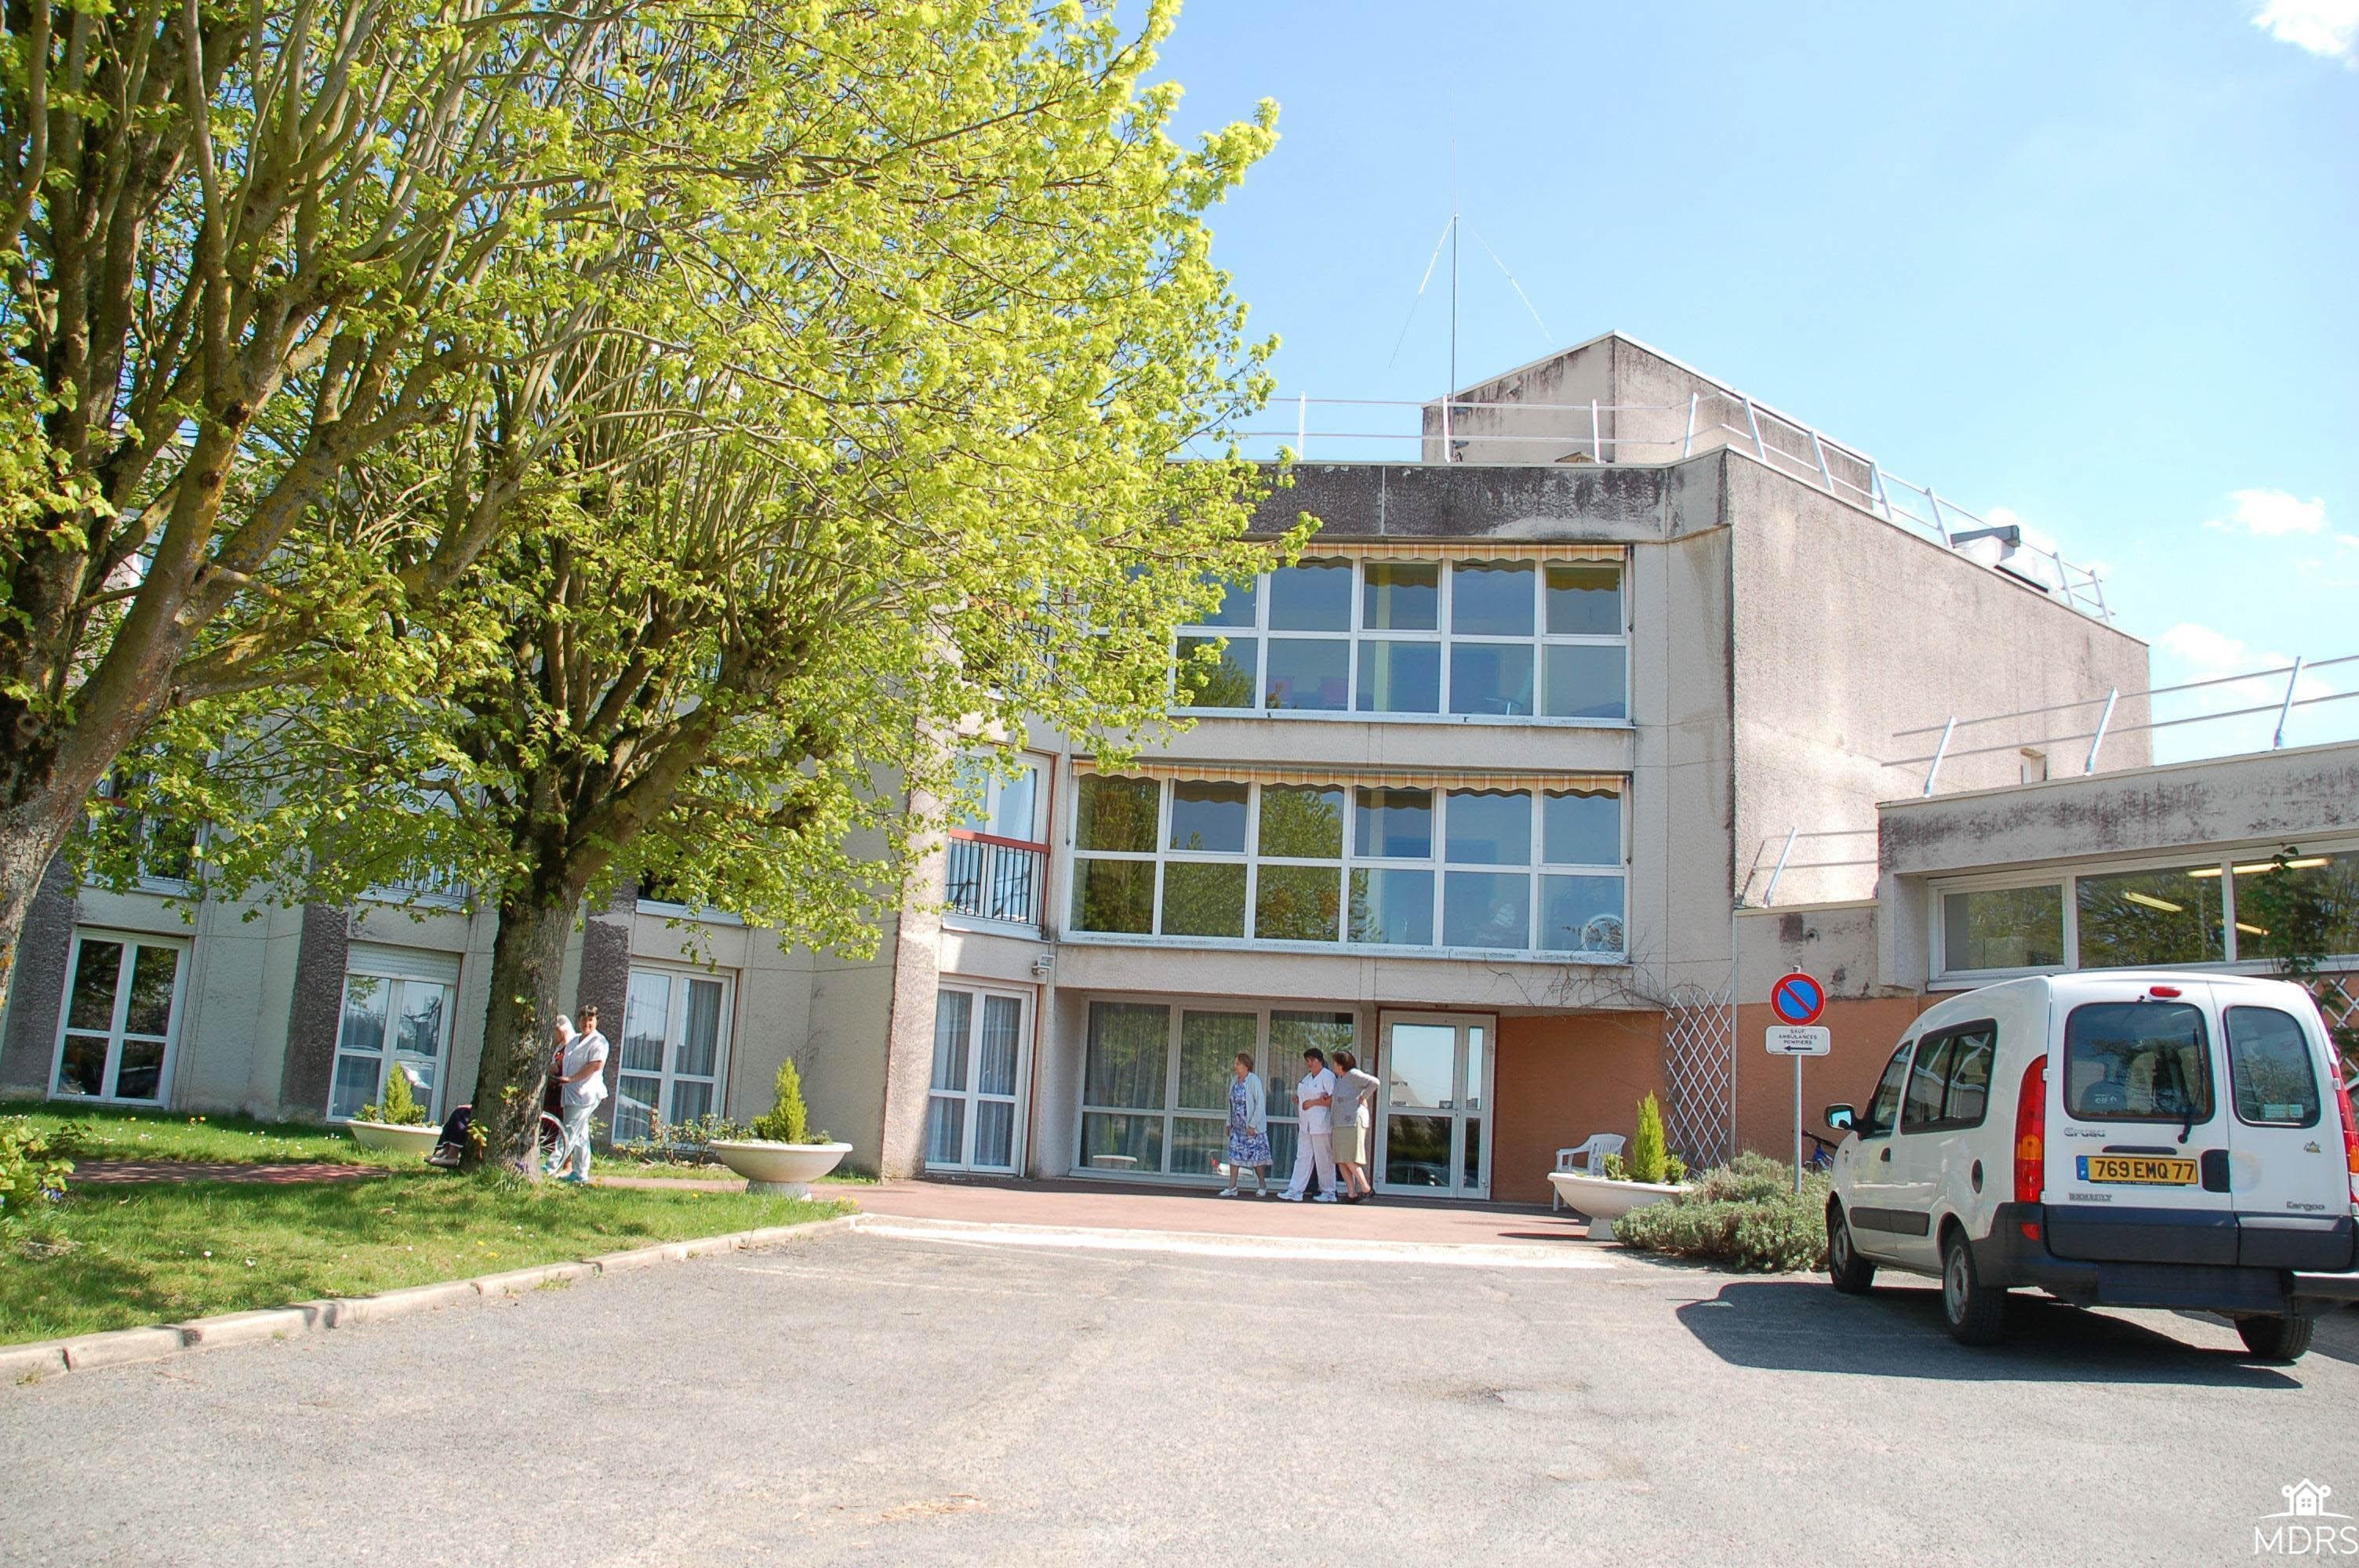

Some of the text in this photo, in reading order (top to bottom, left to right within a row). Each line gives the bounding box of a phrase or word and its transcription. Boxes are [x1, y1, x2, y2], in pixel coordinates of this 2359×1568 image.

[2095, 1160, 2194, 1180] 769 EMQ 77
